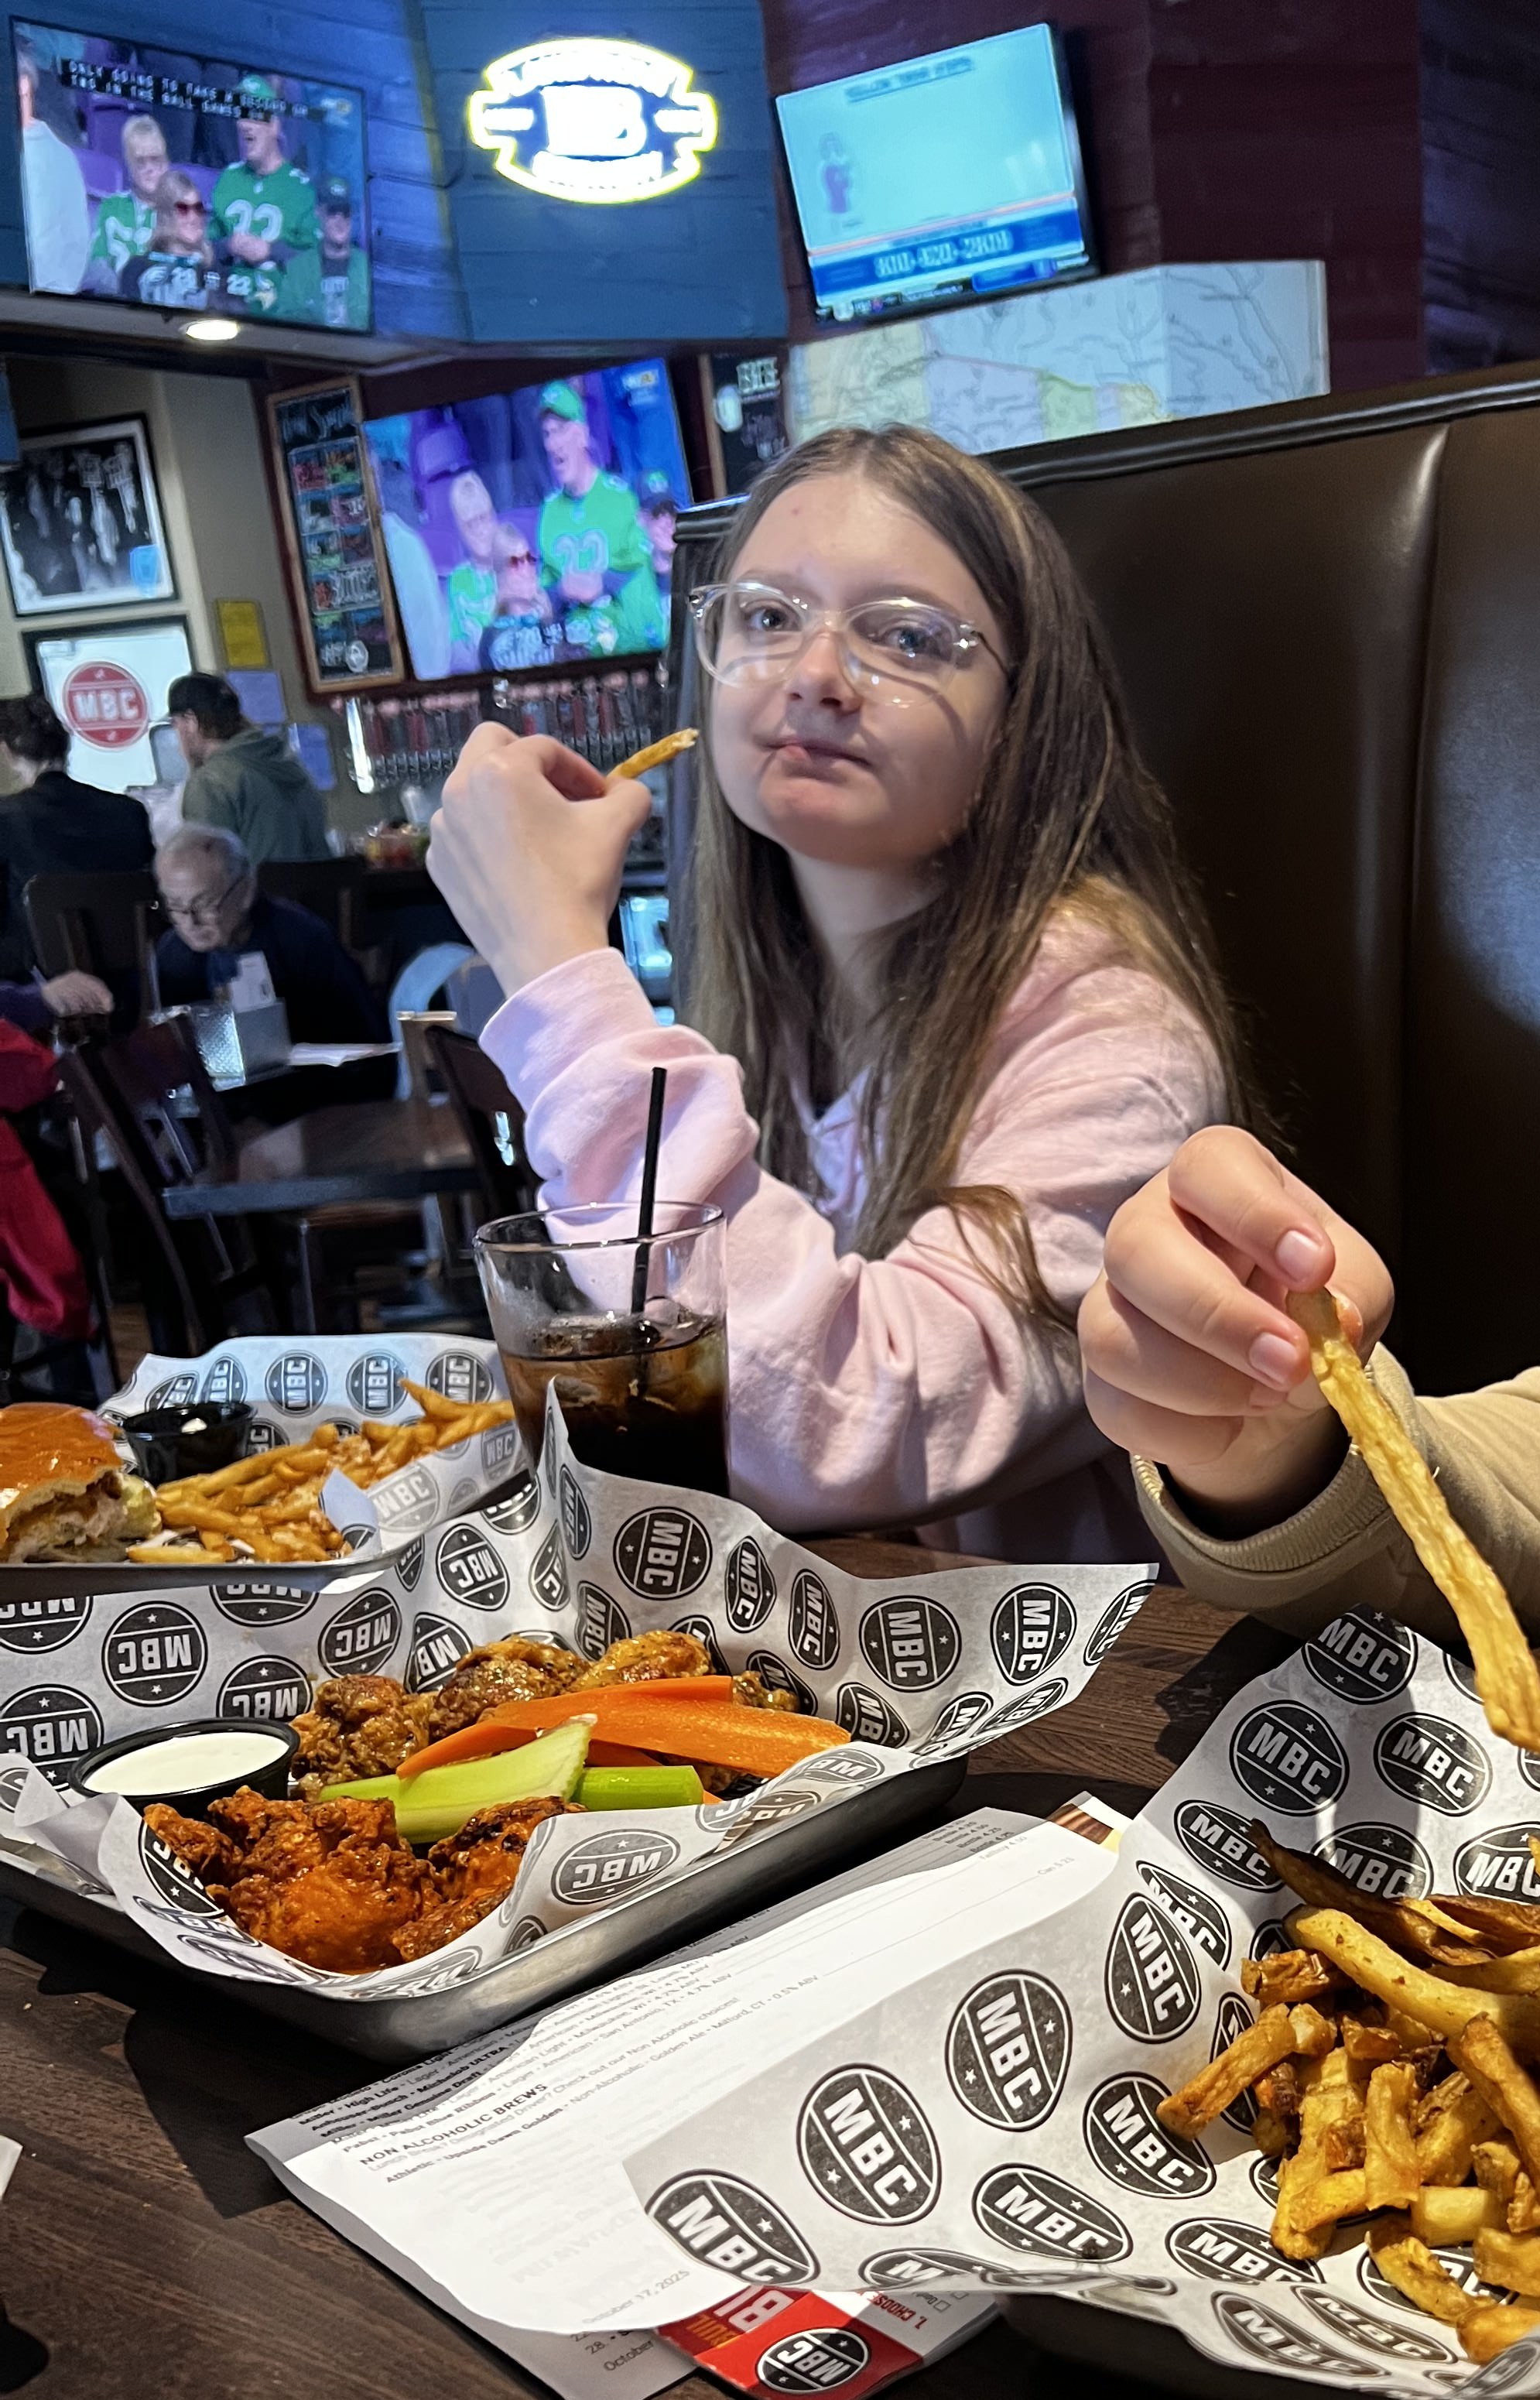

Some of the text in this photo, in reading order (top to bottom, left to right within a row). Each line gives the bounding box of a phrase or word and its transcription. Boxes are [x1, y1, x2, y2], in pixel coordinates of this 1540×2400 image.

[72, 689, 140, 721] MBC
[287, 1359, 307, 1408] MBC
[366, 1357, 389, 1410] MBC
[448, 1549, 498, 1589] MBC
[642, 1519, 683, 1588] MBC
[736, 1551, 758, 1620] MBC
[334, 1612, 392, 1659] MBC
[805, 1581, 825, 1659] MBC
[887, 1609, 928, 1679] MBC
[1017, 1598, 1052, 1672] MBC
[1317, 1617, 1399, 1683] MBC
[118, 1633, 193, 1675] MBC
[6, 1717, 90, 1757] MBC
[858, 1693, 885, 1740] MB
[1247, 1721, 1331, 1796] MBC
[1391, 1731, 1476, 1799] MBC
[1189, 1812, 1271, 1878] MBC
[1331, 1847, 1416, 1902] MBC
[1130, 1912, 1186, 2022] MBC
[416, 2064, 470, 2094] Michelob
[469, 2043, 509, 2067] ULTRA
[513, 2090, 552, 2117] Driver?
[552, 2073, 588, 2094] Check
[587, 2063, 608, 2076] out
[607, 2054, 625, 2066] our
[625, 2042, 651, 2056] Non
[651, 2017, 699, 2045] Alcoholic
[976, 1990, 1042, 2111] MBC
[344, 2094, 375, 2108] High
[374, 2084, 399, 2098] Life
[406, 2067, 440, 2086] Lager
[385, 2159, 434, 2183] Athletic
[443, 2143, 487, 2161] Upside
[521, 2105, 563, 2131] Golden
[570, 2061, 645, 2104] Non-Alcoholic
[649, 2039, 688, 2063] Golden
[688, 2029, 706, 2041] Ale
[403, 2087, 452, 2111] Genuine
[452, 2069, 482, 2088] Draft
[453, 2090, 495, 2114] Ribbon
[501, 2070, 535, 2089] Lager
[359, 2081, 548, 2165] NON ALCOHOLIC BREWS
[823, 2087, 918, 2207] MBC
[1103, 2094, 1196, 2189] MBC
[666, 2196, 792, 2285] MBC
[994, 2183, 1109, 2260] MBC
[655, 2267, 691, 2292] 2025
[602, 2338, 656, 2373] October
[1234, 2308, 1368, 2377] MBC
[1313, 2296, 1432, 2358] MBC
[772, 2340, 850, 2386] MBC
